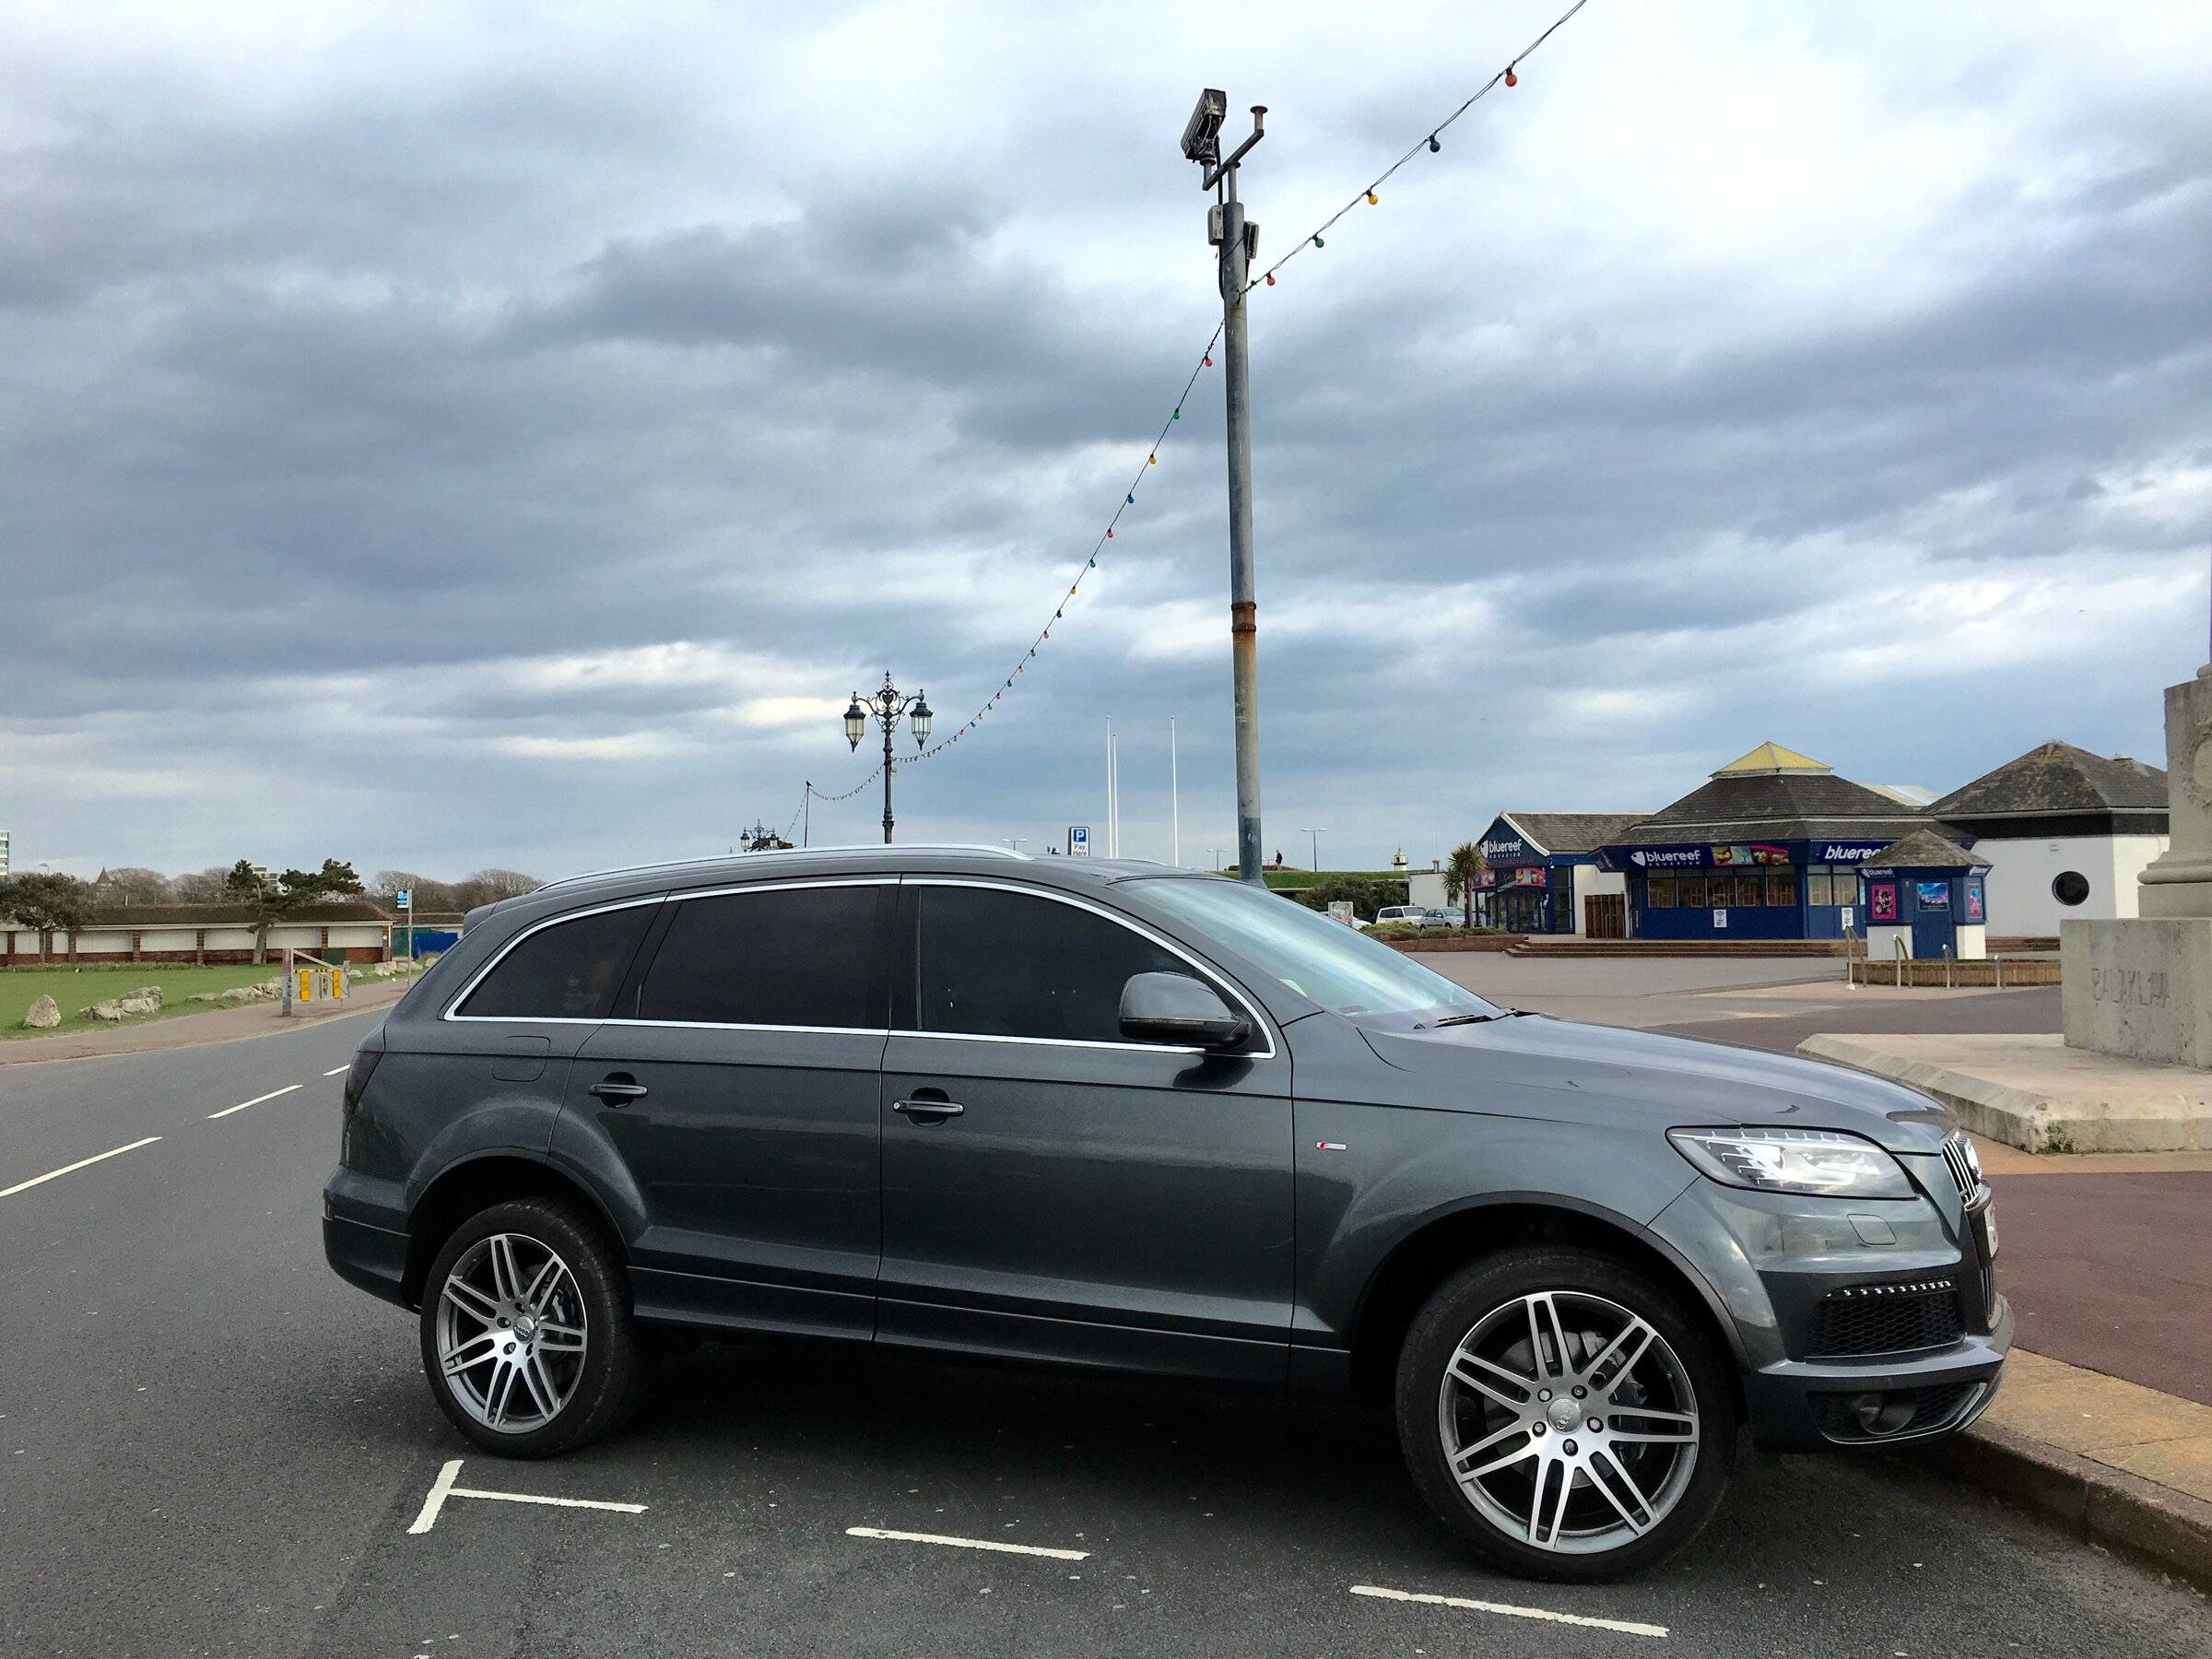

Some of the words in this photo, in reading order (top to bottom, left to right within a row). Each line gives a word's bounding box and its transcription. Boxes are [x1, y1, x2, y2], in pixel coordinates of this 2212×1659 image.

[1076, 830, 1085, 841] P
[1488, 838, 1522, 853] bluereef
[1645, 850, 1700, 862] bluereef
